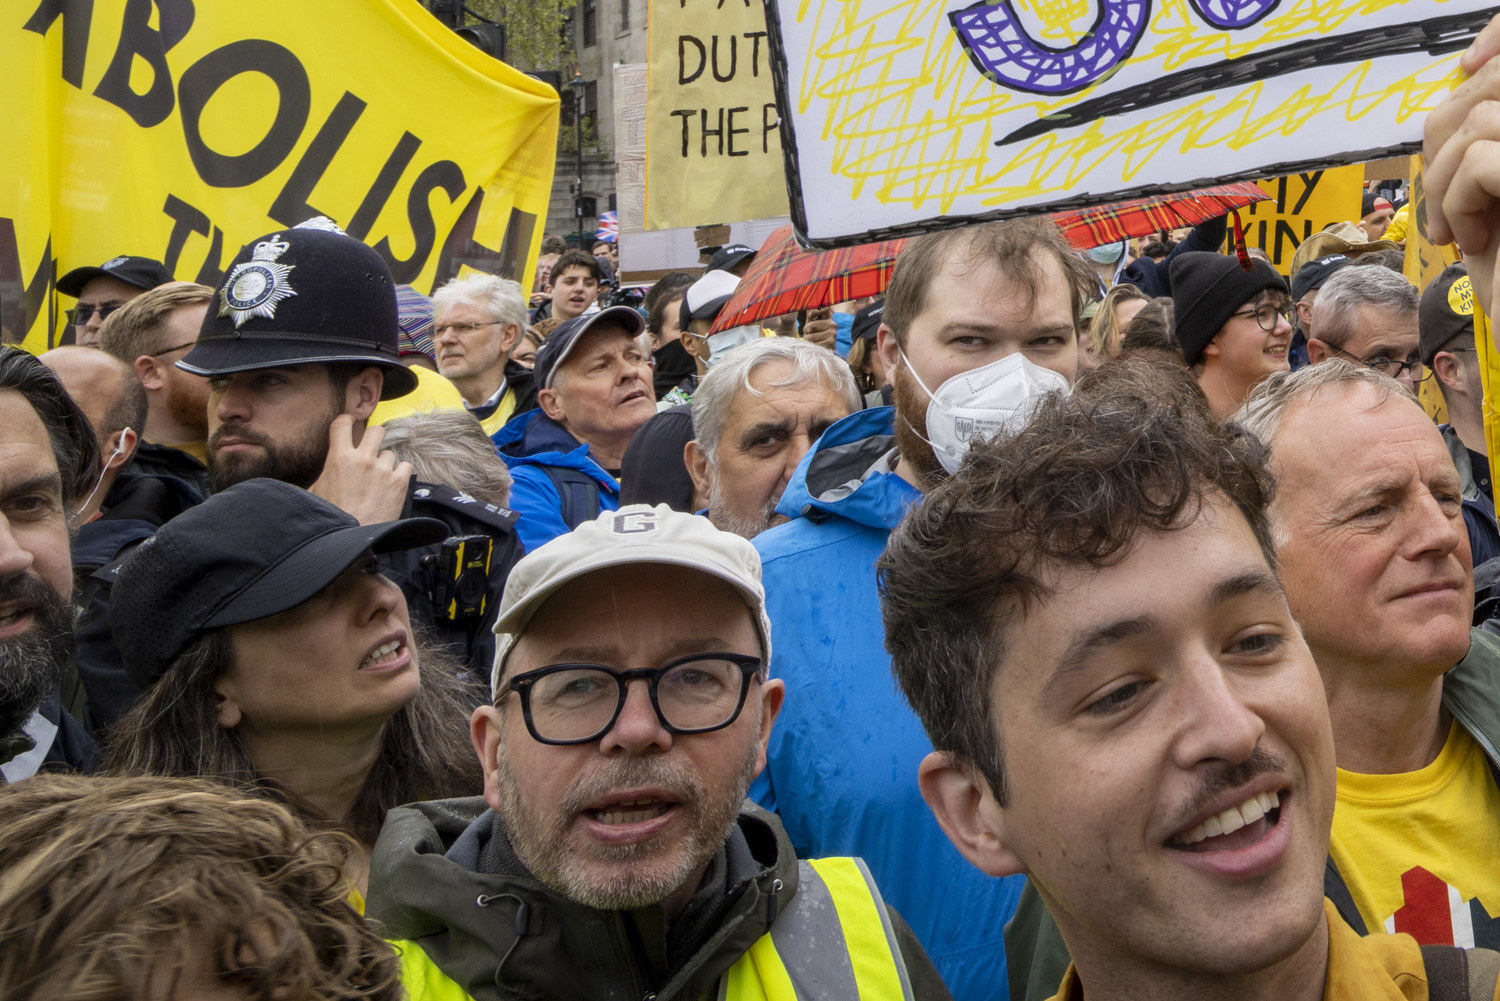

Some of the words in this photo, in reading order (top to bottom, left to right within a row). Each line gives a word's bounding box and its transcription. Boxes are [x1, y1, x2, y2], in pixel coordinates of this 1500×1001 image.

[679, 31, 767, 85] DUT
[670, 106, 748, 157] THE
[1227, 220, 1340, 265] KIN
[229, 298, 258, 307] POLICE
[612, 511, 656, 534] G
